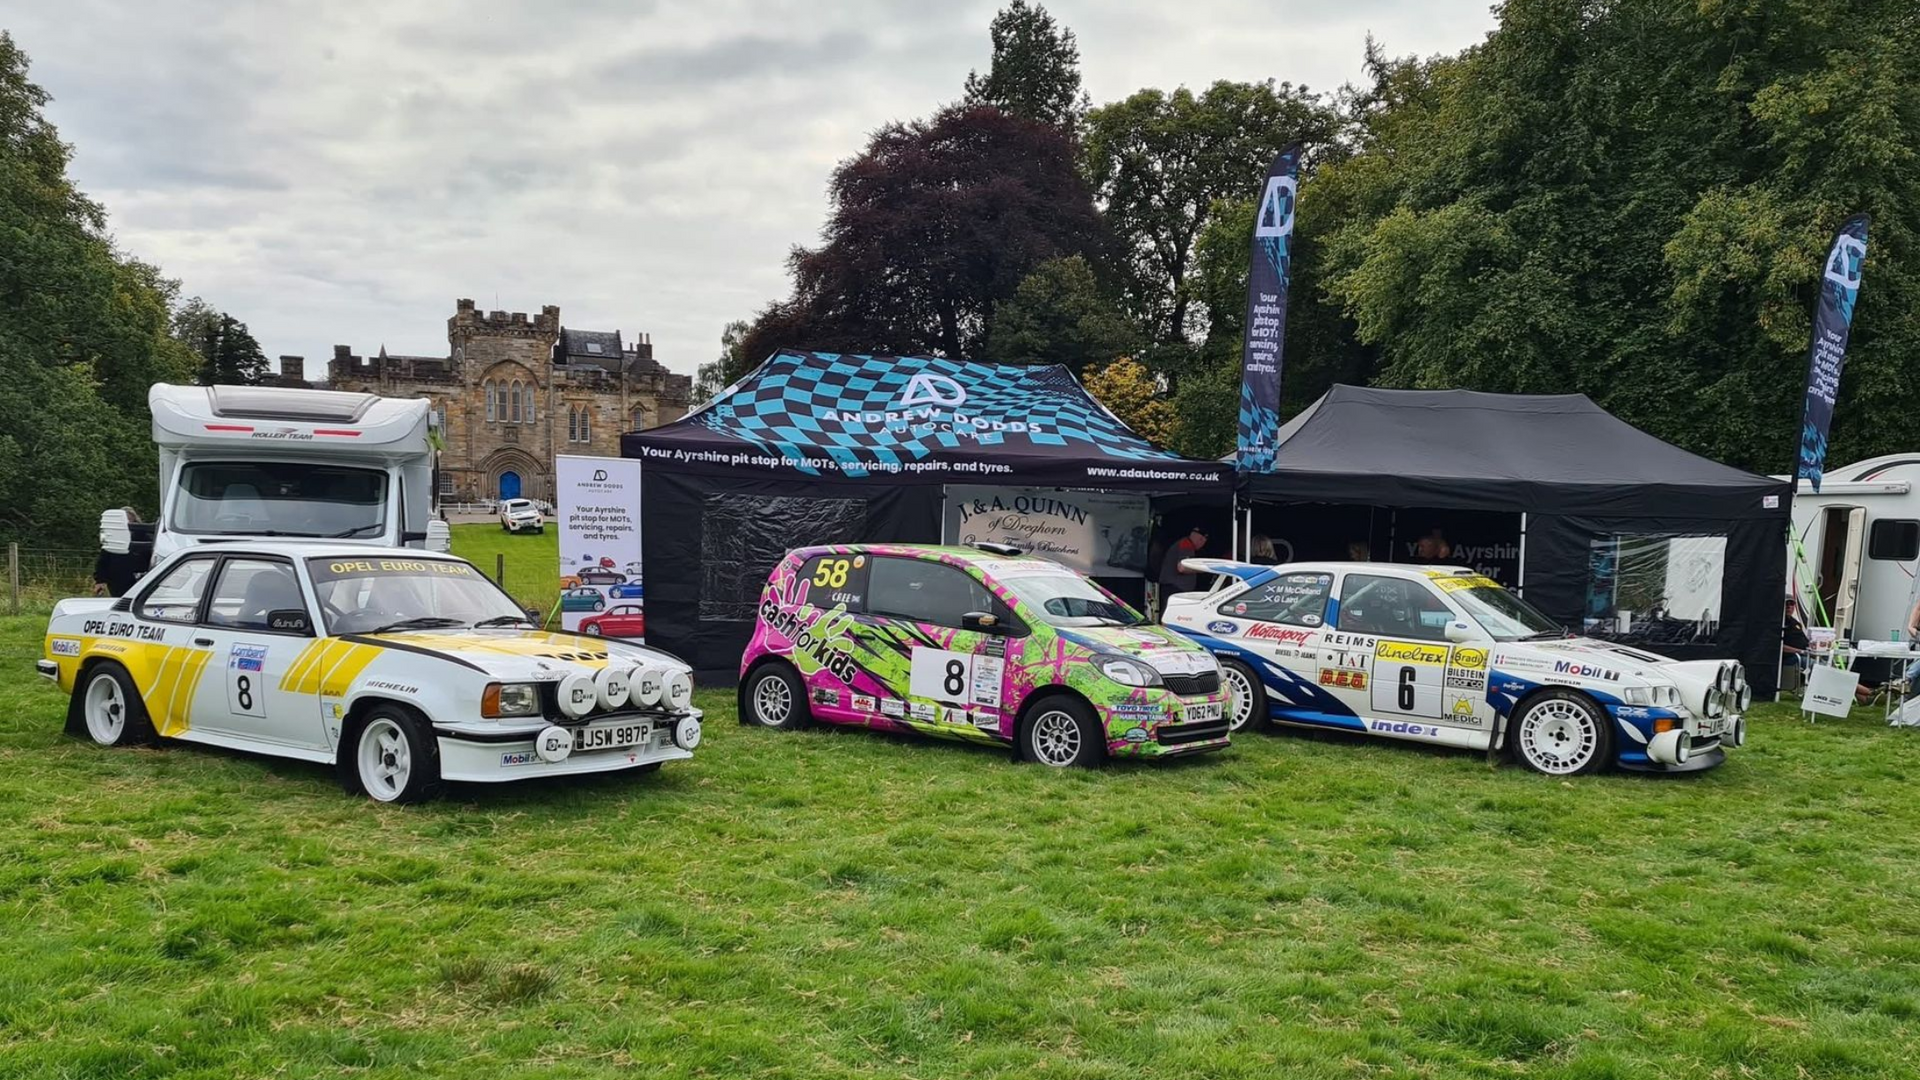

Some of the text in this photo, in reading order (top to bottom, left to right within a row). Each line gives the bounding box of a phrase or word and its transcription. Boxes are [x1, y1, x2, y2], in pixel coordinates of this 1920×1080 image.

[822, 407, 1042, 433] ANDREW DODDS
[879, 421, 993, 442] AUTOCARE
[641, 446, 1013, 475] Your Ayrshire pit stop for MOTs, servicing, repairs, and tyres.
[1087, 467, 1220, 482] www.adautocare.co.uk
[594, 506, 626, 515] Ayrshire
[957, 503, 973, 523] J.
[973, 498, 988, 515] &
[991, 495, 1011, 512] A.
[1015, 495, 1089, 526] QUINN
[569, 514, 580, 522] pit
[581, 515, 597, 523] stop
[988, 514, 1068, 538] of Dreghorn
[583, 532, 598, 540] and
[1037, 541, 1079, 555] Butchers
[330, 561, 470, 576] OPEL EURO TEAM
[813, 558, 850, 588] 58
[1276, 586, 1284, 594] M
[83, 620, 166, 642] OPEL EURO TEAM
[1210, 622, 1235, 634] Ford
[1243, 622, 1319, 647] Motorsport
[1324, 633, 1375, 648] REIMS
[231, 645, 266, 658] Lombard
[1275, 648, 1292, 657] DIESEL
[1447, 668, 1485, 679] BILSTEIN
[1554, 660, 1602, 678] Mobil
[944, 659, 965, 696] 8
[1544, 677, 1581, 686] MICHELIN
[237, 675, 253, 710] 8
[366, 680, 419, 694] MICHELIN
[1398, 666, 1416, 710] 6
[1186, 706, 1206, 721] YD62
[1444, 713, 1482, 726] MEDICI
[1371, 719, 1438, 736] index
[585, 727, 613, 748] JSW
[616, 725, 649, 744] 987P
[503, 753, 529, 765] Mobil
